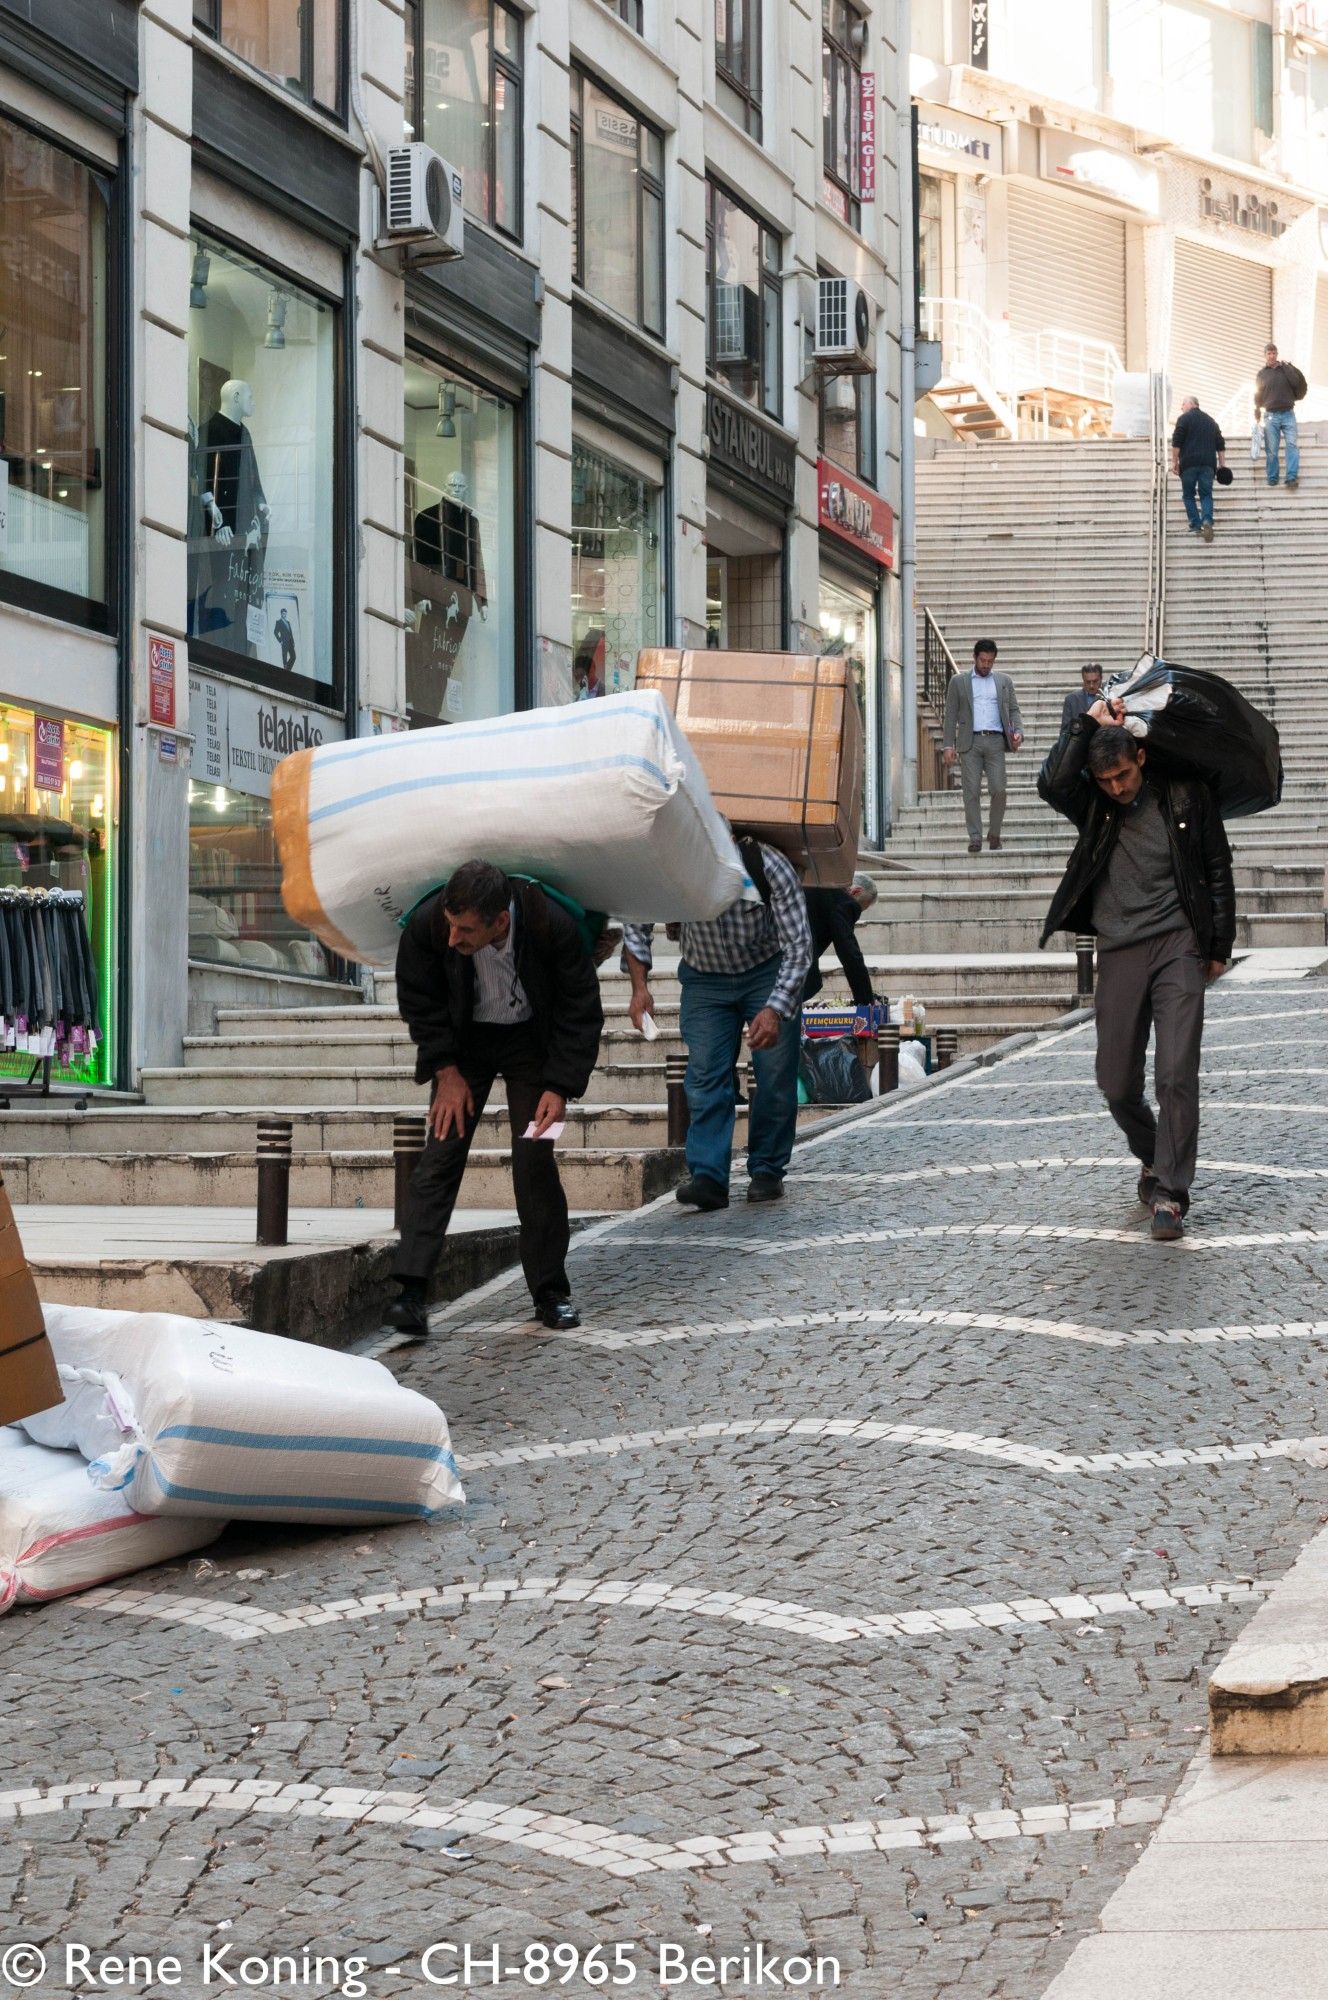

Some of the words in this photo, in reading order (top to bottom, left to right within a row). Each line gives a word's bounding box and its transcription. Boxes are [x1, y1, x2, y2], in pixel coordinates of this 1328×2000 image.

[206, 685, 216, 697] TELA
[206, 698, 217, 710] TELA
[206, 711, 217, 722] TELA
[206, 724, 217, 736] TELA
[257, 705, 323, 754] telateks
[232, 747, 256, 770] TEKSTİL
[806, 1017, 854, 1027] EFEMÇUKURU
